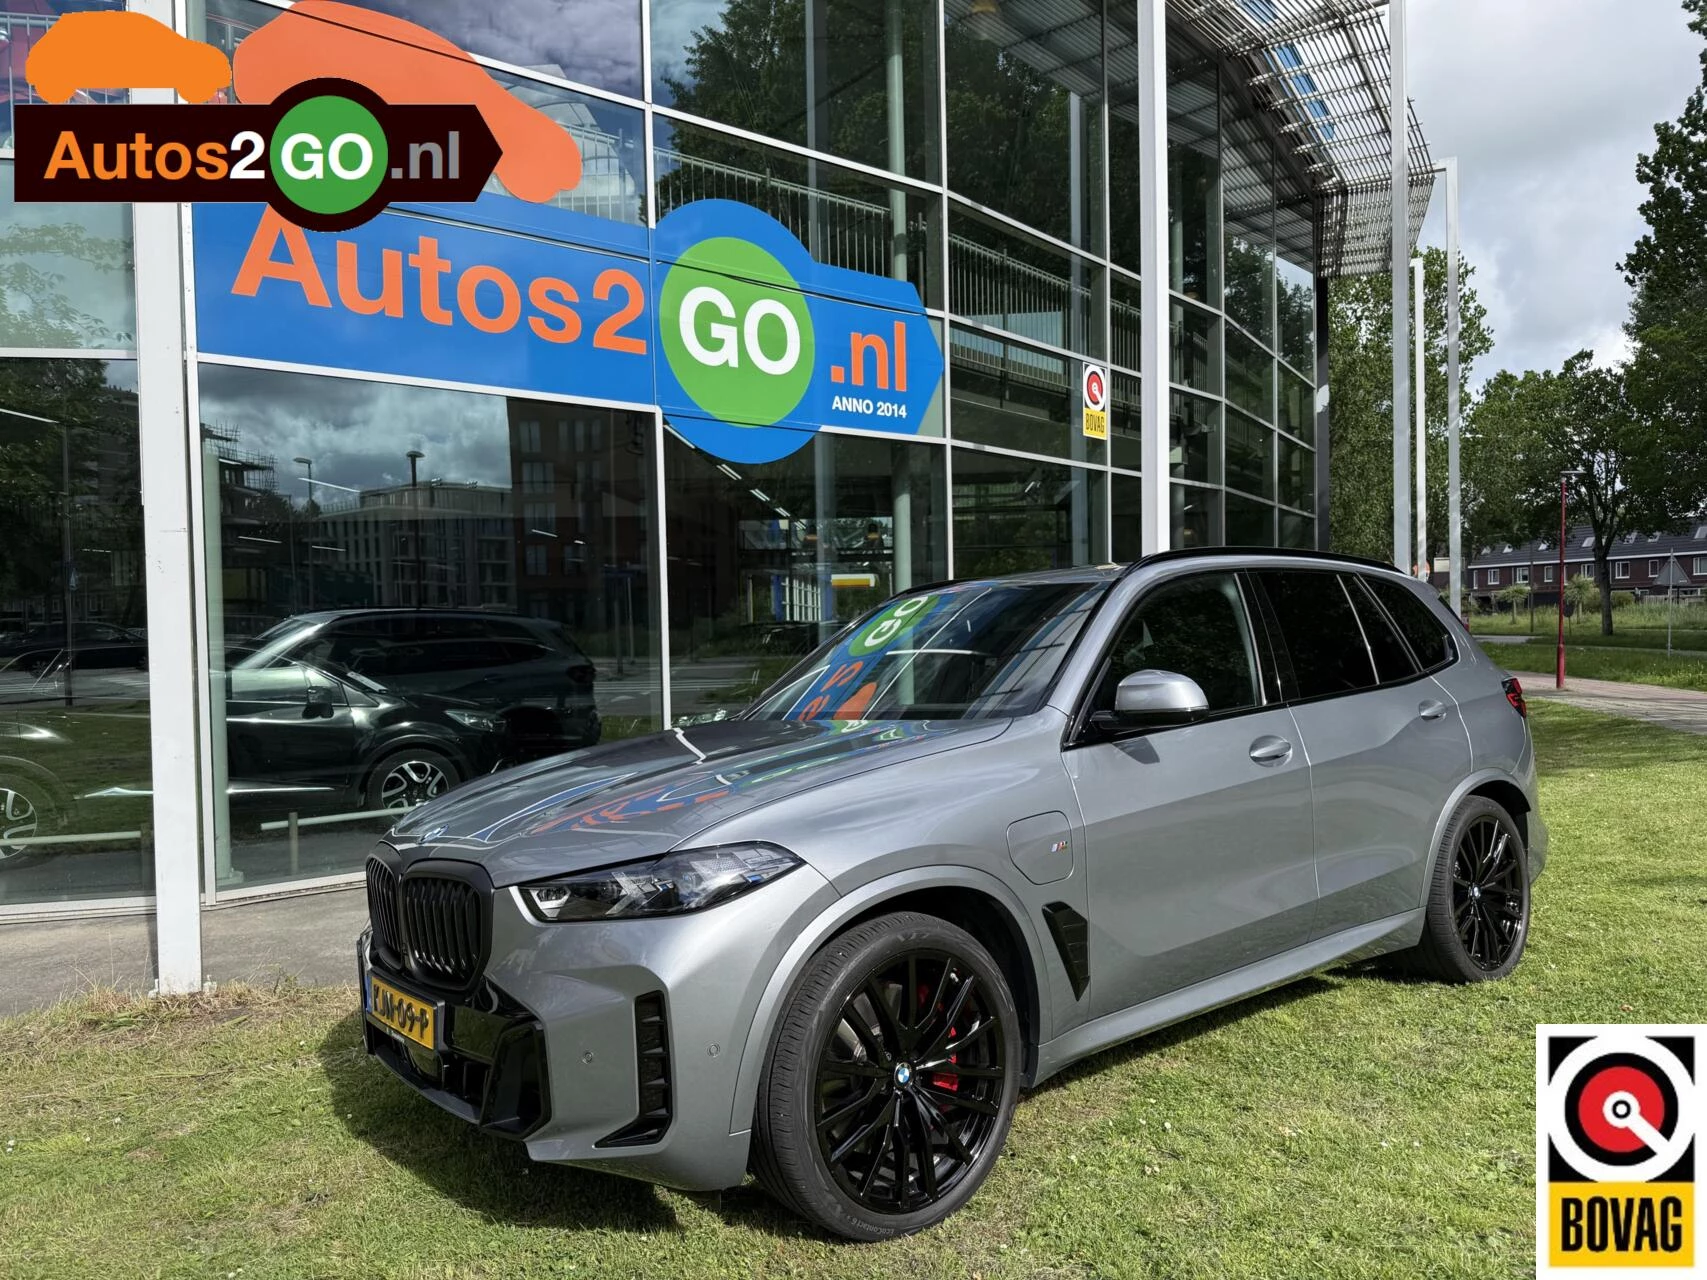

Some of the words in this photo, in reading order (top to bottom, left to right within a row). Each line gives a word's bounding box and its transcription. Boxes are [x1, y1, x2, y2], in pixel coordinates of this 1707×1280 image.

[832, 395, 874, 415] ANNO
[876, 401, 907, 419] 2014
[1085, 412, 1105, 433] BOVAG
